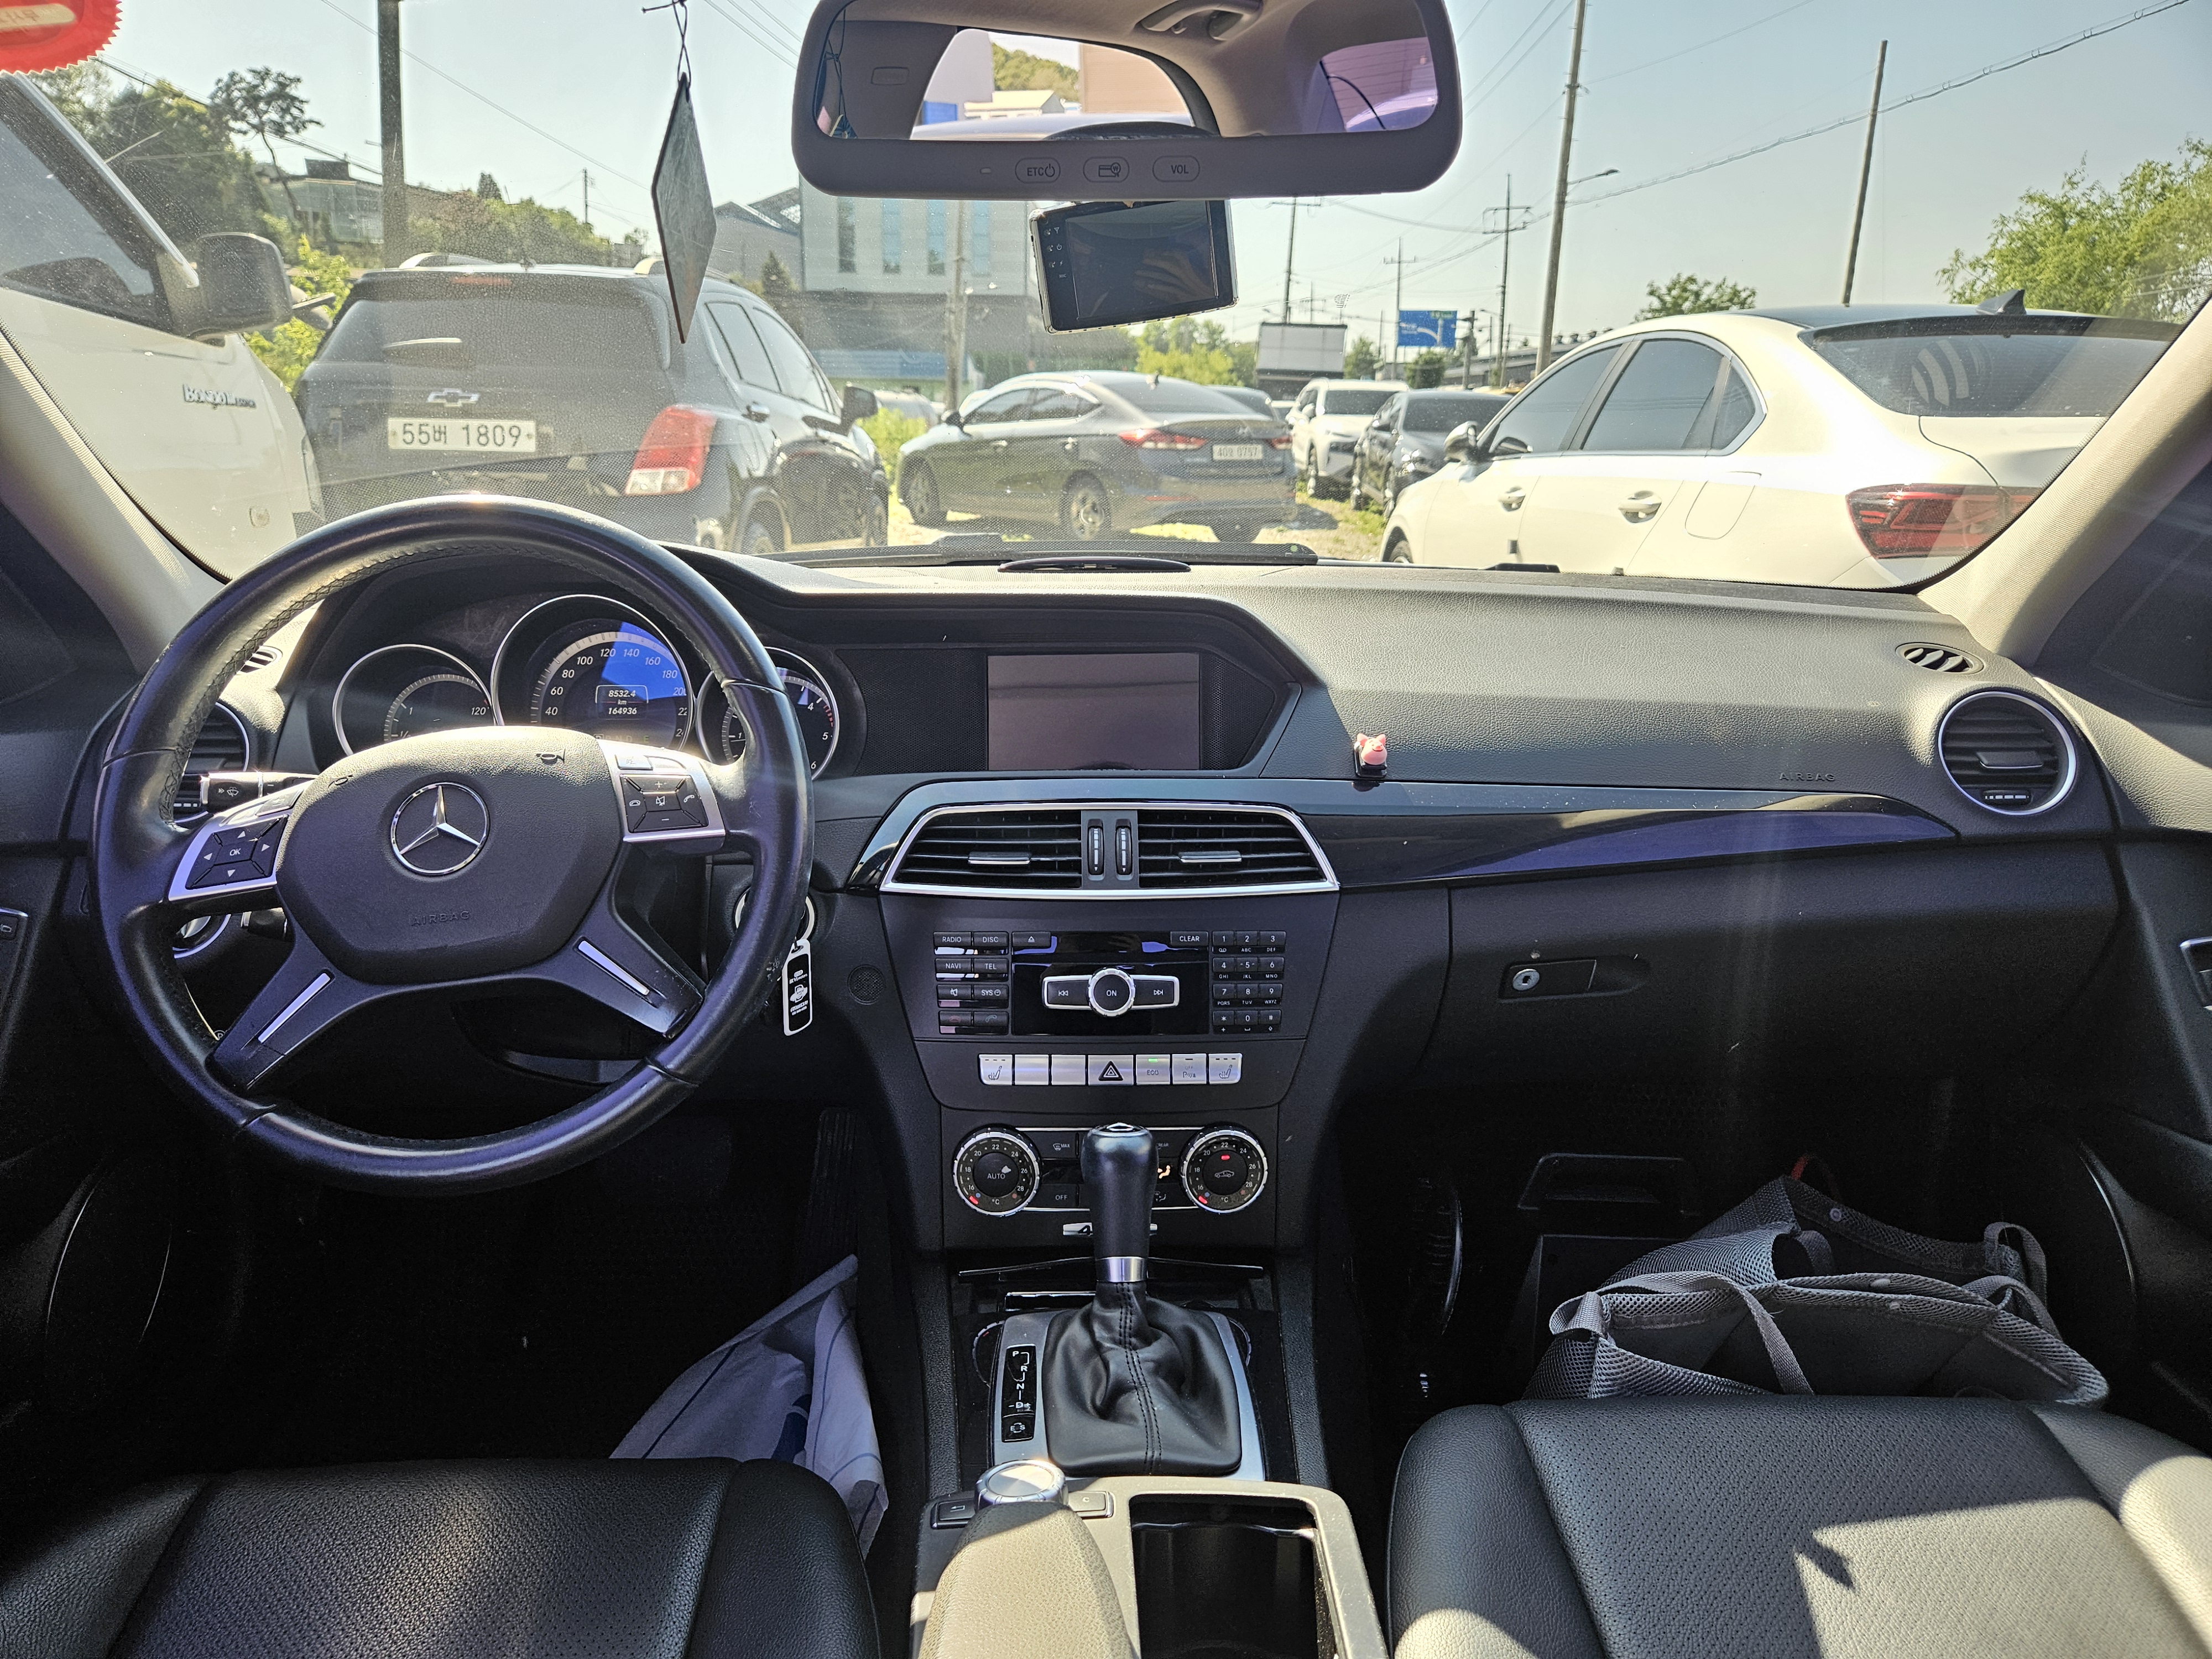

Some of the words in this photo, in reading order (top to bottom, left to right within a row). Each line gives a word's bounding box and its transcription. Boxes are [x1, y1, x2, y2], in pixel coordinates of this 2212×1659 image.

[1027, 167, 1044, 176] ETC
[1171, 165, 1189, 174] VOL
[402, 423, 447, 445] 55버
[462, 424, 521, 447] 1809
[601, 649, 617, 658] 120
[623, 649, 640, 658] 140
[577, 656, 593, 665] 100
[645, 656, 661, 665] 160
[562, 669, 575, 679] 80
[662, 670, 678, 679] 180
[550, 686, 564, 696] 60
[409, 707, 414, 715] 1
[807, 702, 815, 711] 4
[545, 707, 559, 716] 40
[822, 732, 829, 740] 5
[810, 761, 817, 769] 6
[1779, 772, 1836, 781] AIRBAG
[229, 848, 242, 856] OK
[411, 910, 469, 927] AIRBAG
